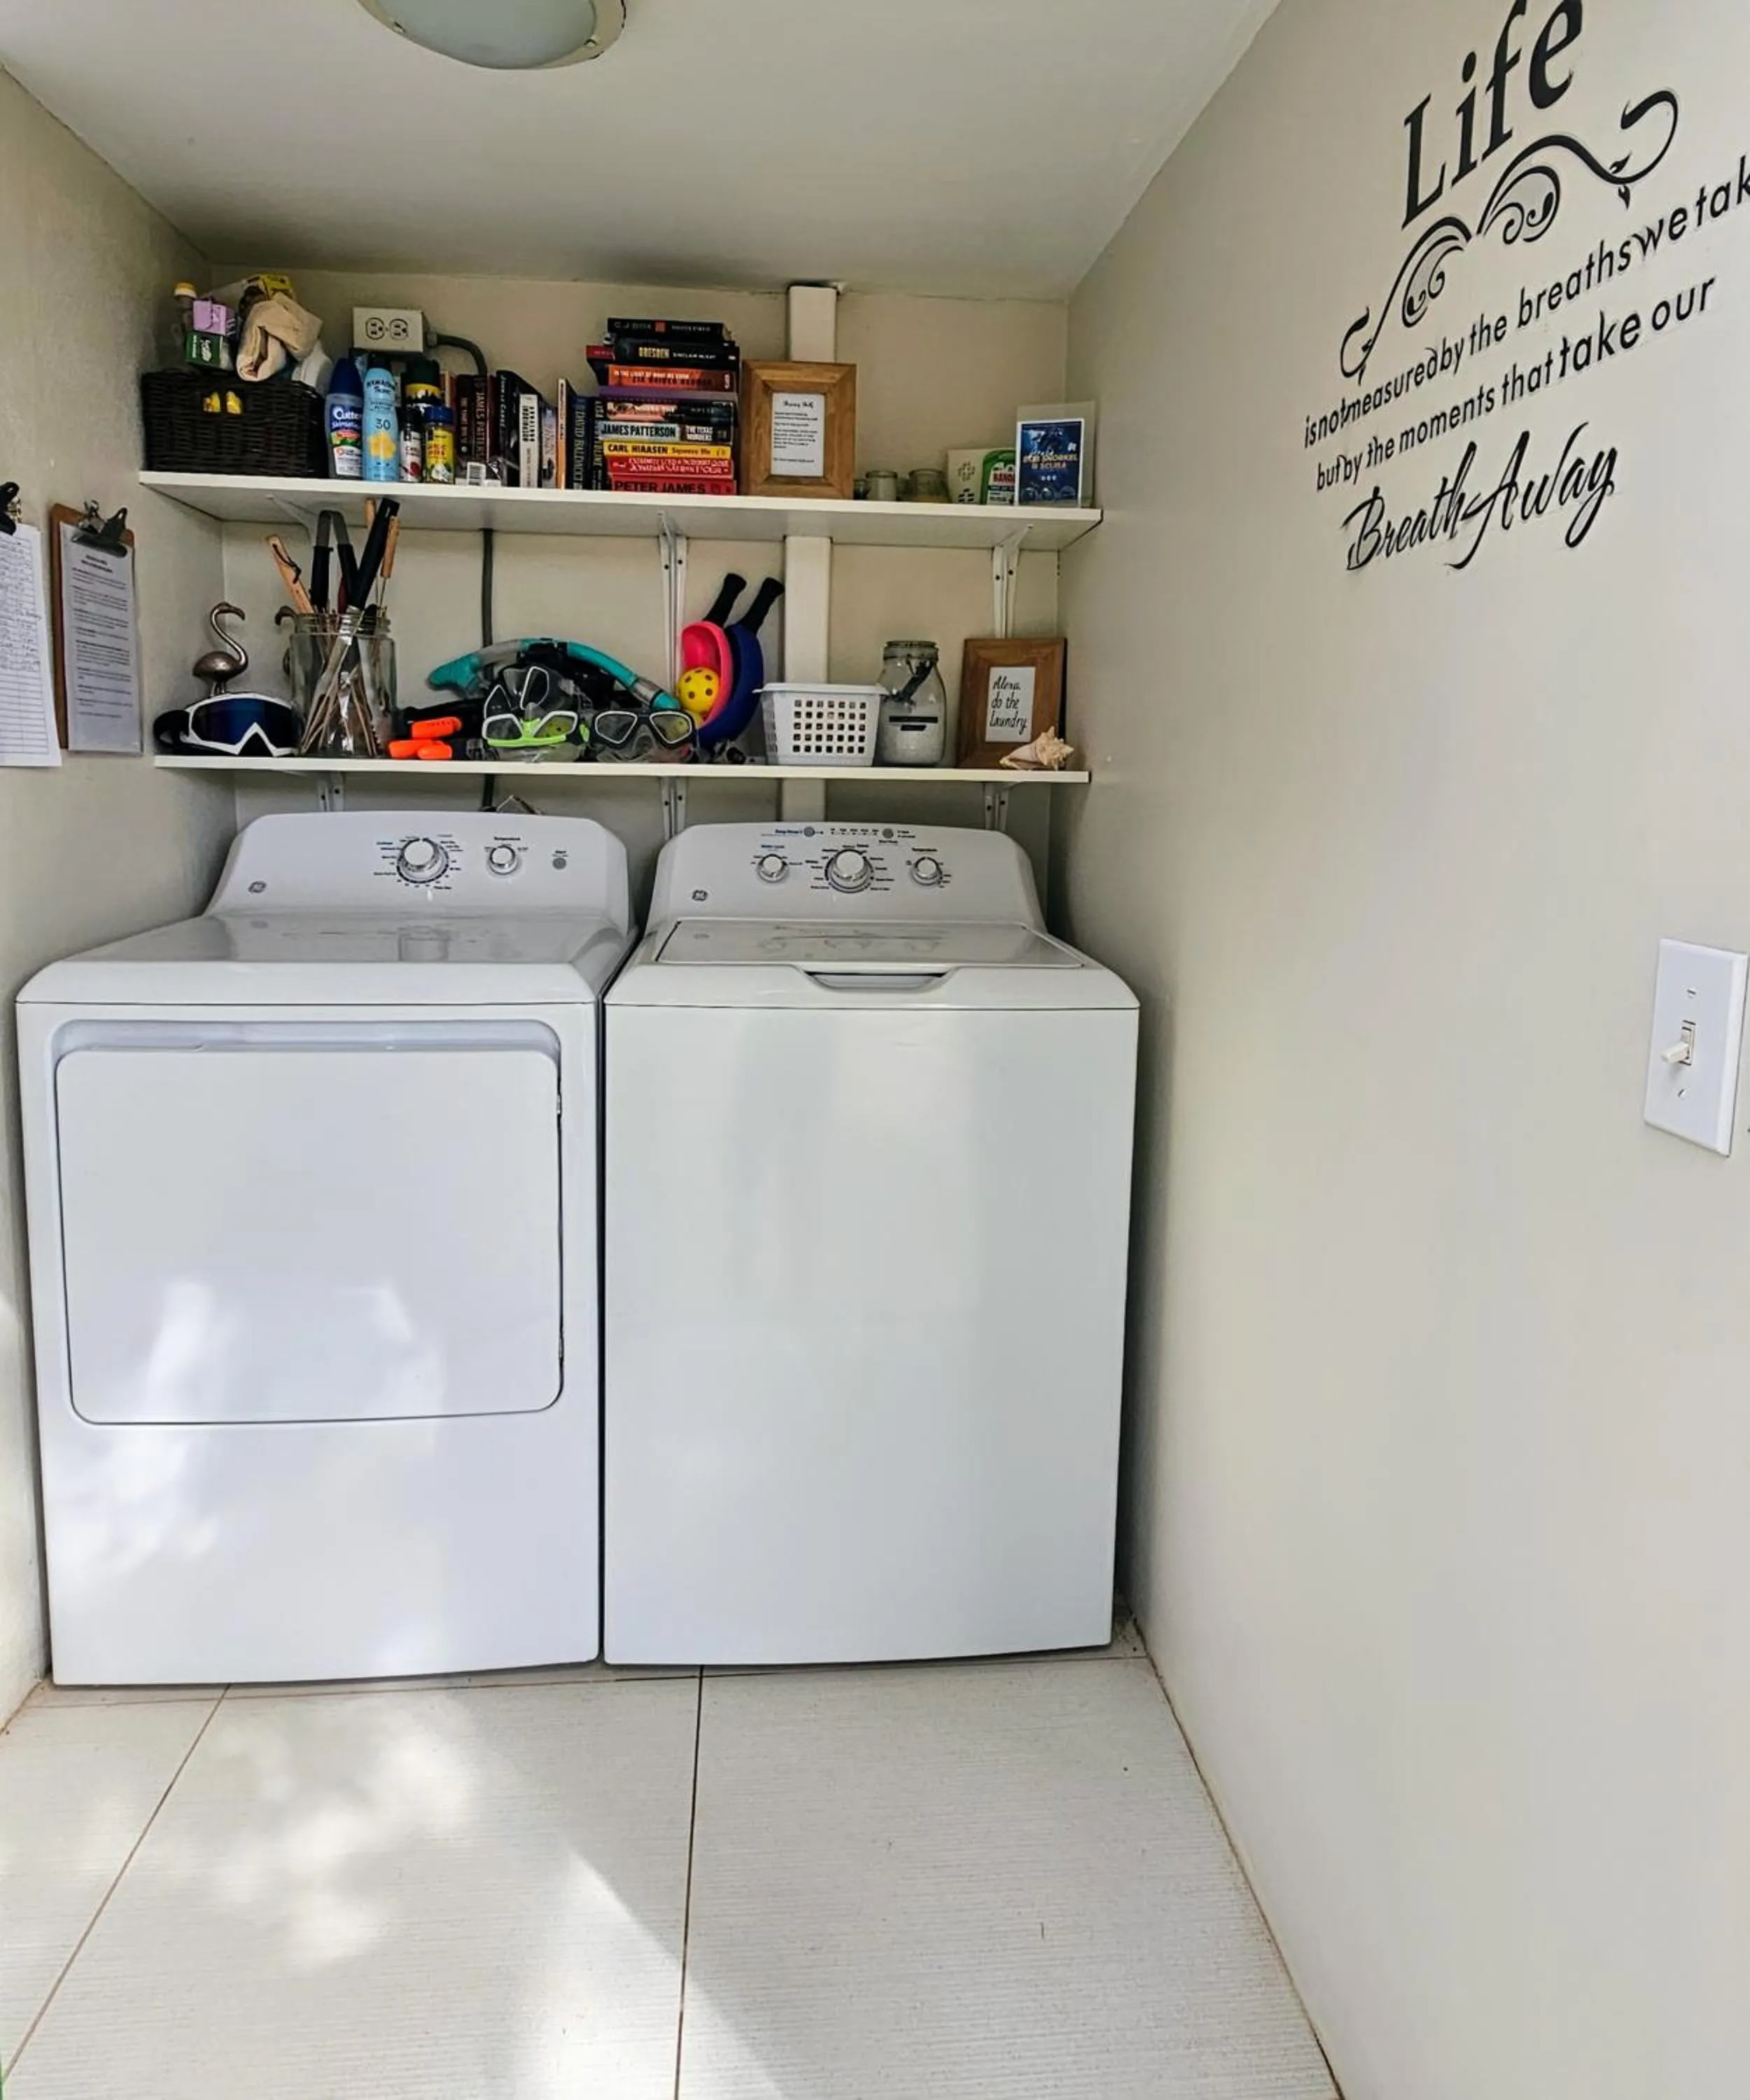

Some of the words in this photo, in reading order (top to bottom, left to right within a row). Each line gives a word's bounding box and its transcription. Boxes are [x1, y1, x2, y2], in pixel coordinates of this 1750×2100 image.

[1401, 0, 1583, 230] Life
[1469, 313, 1507, 356] the
[1517, 239, 1632, 328] breaths
[1366, 436, 1395, 468] the
[1399, 385, 1495, 454] moments
[1501, 351, 1554, 406] that
[1558, 310, 1642, 379] take
[1651, 276, 1716, 332] our
[476, 392, 485, 419] JAMES
[601, 423, 629, 436] JAMES
[631, 424, 676, 437] PATTERSON
[608, 444, 629, 453] CARL
[632, 445, 668, 454] HIAASEN
[614, 482, 659, 492] PETER
[663, 482, 706, 493] JAMES
[1341, 441, 1477, 570] Breath
[1445, 422, 1618, 570] Away
[991, 691, 1002, 708] do
[1005, 691, 1020, 709] the
